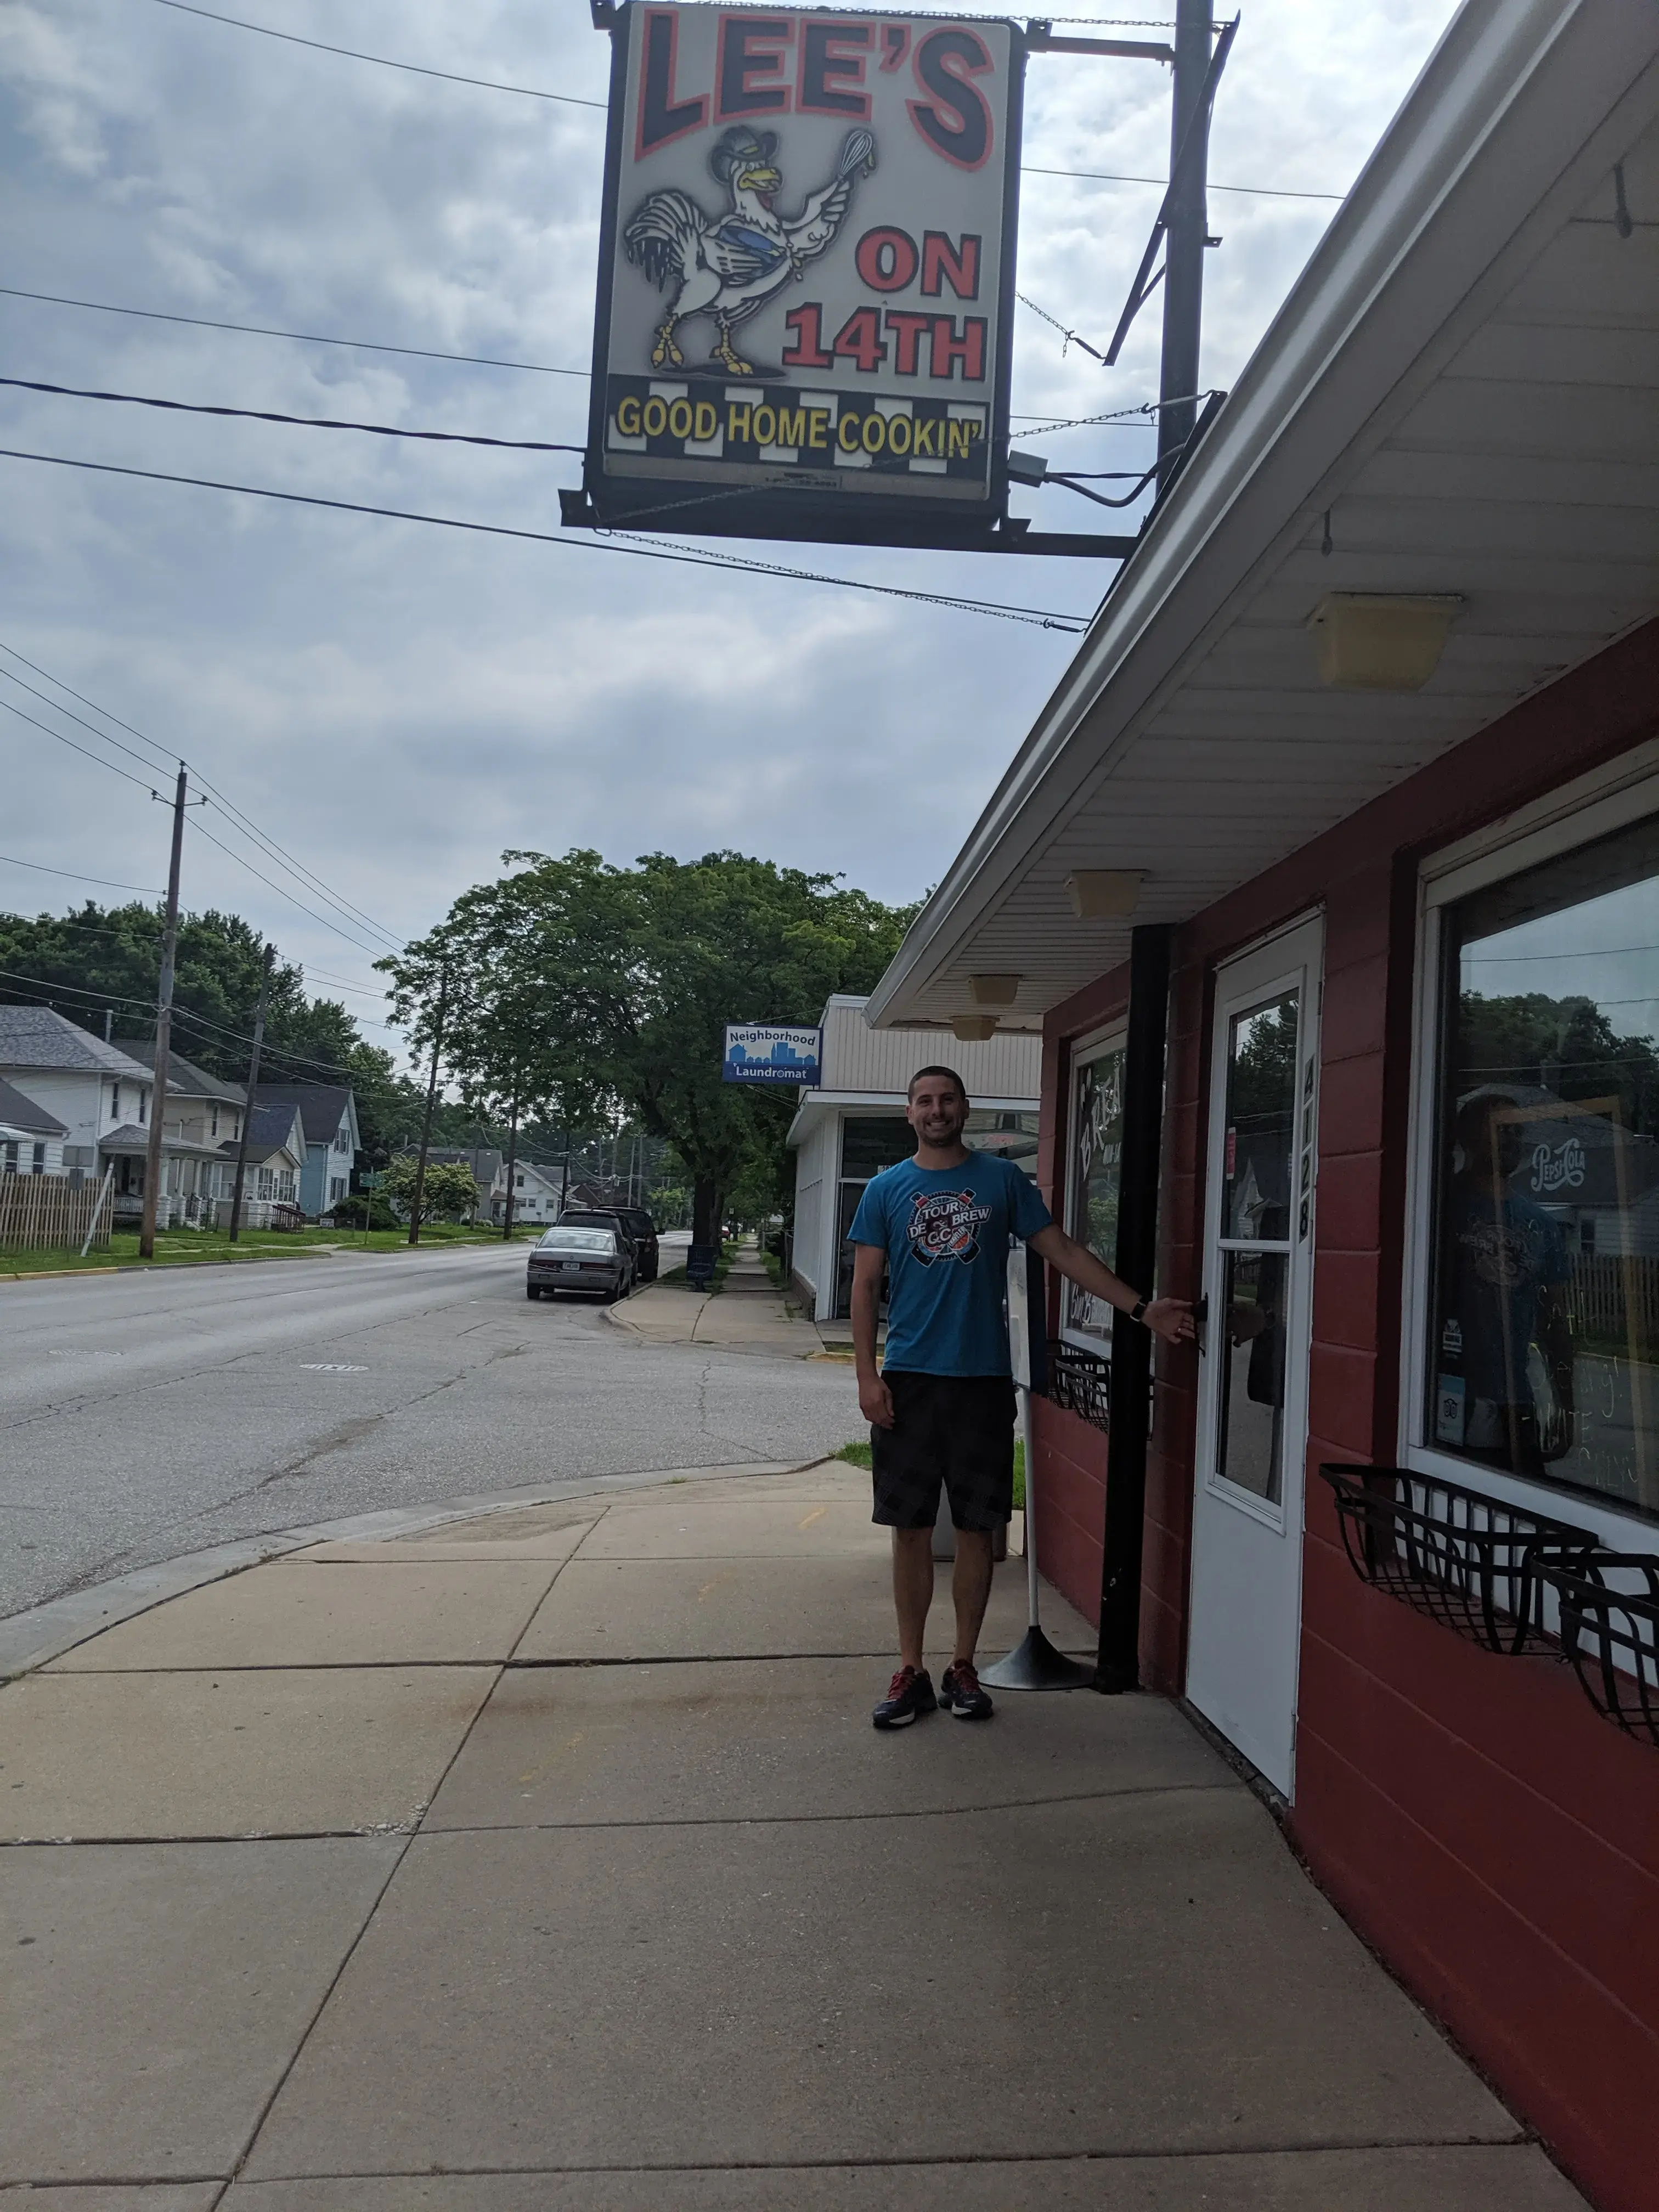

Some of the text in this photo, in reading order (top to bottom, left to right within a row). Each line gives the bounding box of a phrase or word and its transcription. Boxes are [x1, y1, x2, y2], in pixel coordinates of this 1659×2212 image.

[634, 8, 995, 172] LEE'S
[855, 225, 982, 300] ON
[781, 302, 988, 382] 14TH
[617, 395, 979, 460] GOOD HOME COOKIN'
[730, 1030, 816, 1046] Neighborhood
[736, 1066, 807, 1079] Laundromat
[1299, 1054, 1314, 1237] 4128
[910, 1207, 990, 1239] DE BREW
[922, 1200, 960, 1220] TOUR
[927, 1227, 952, 1245] QC
